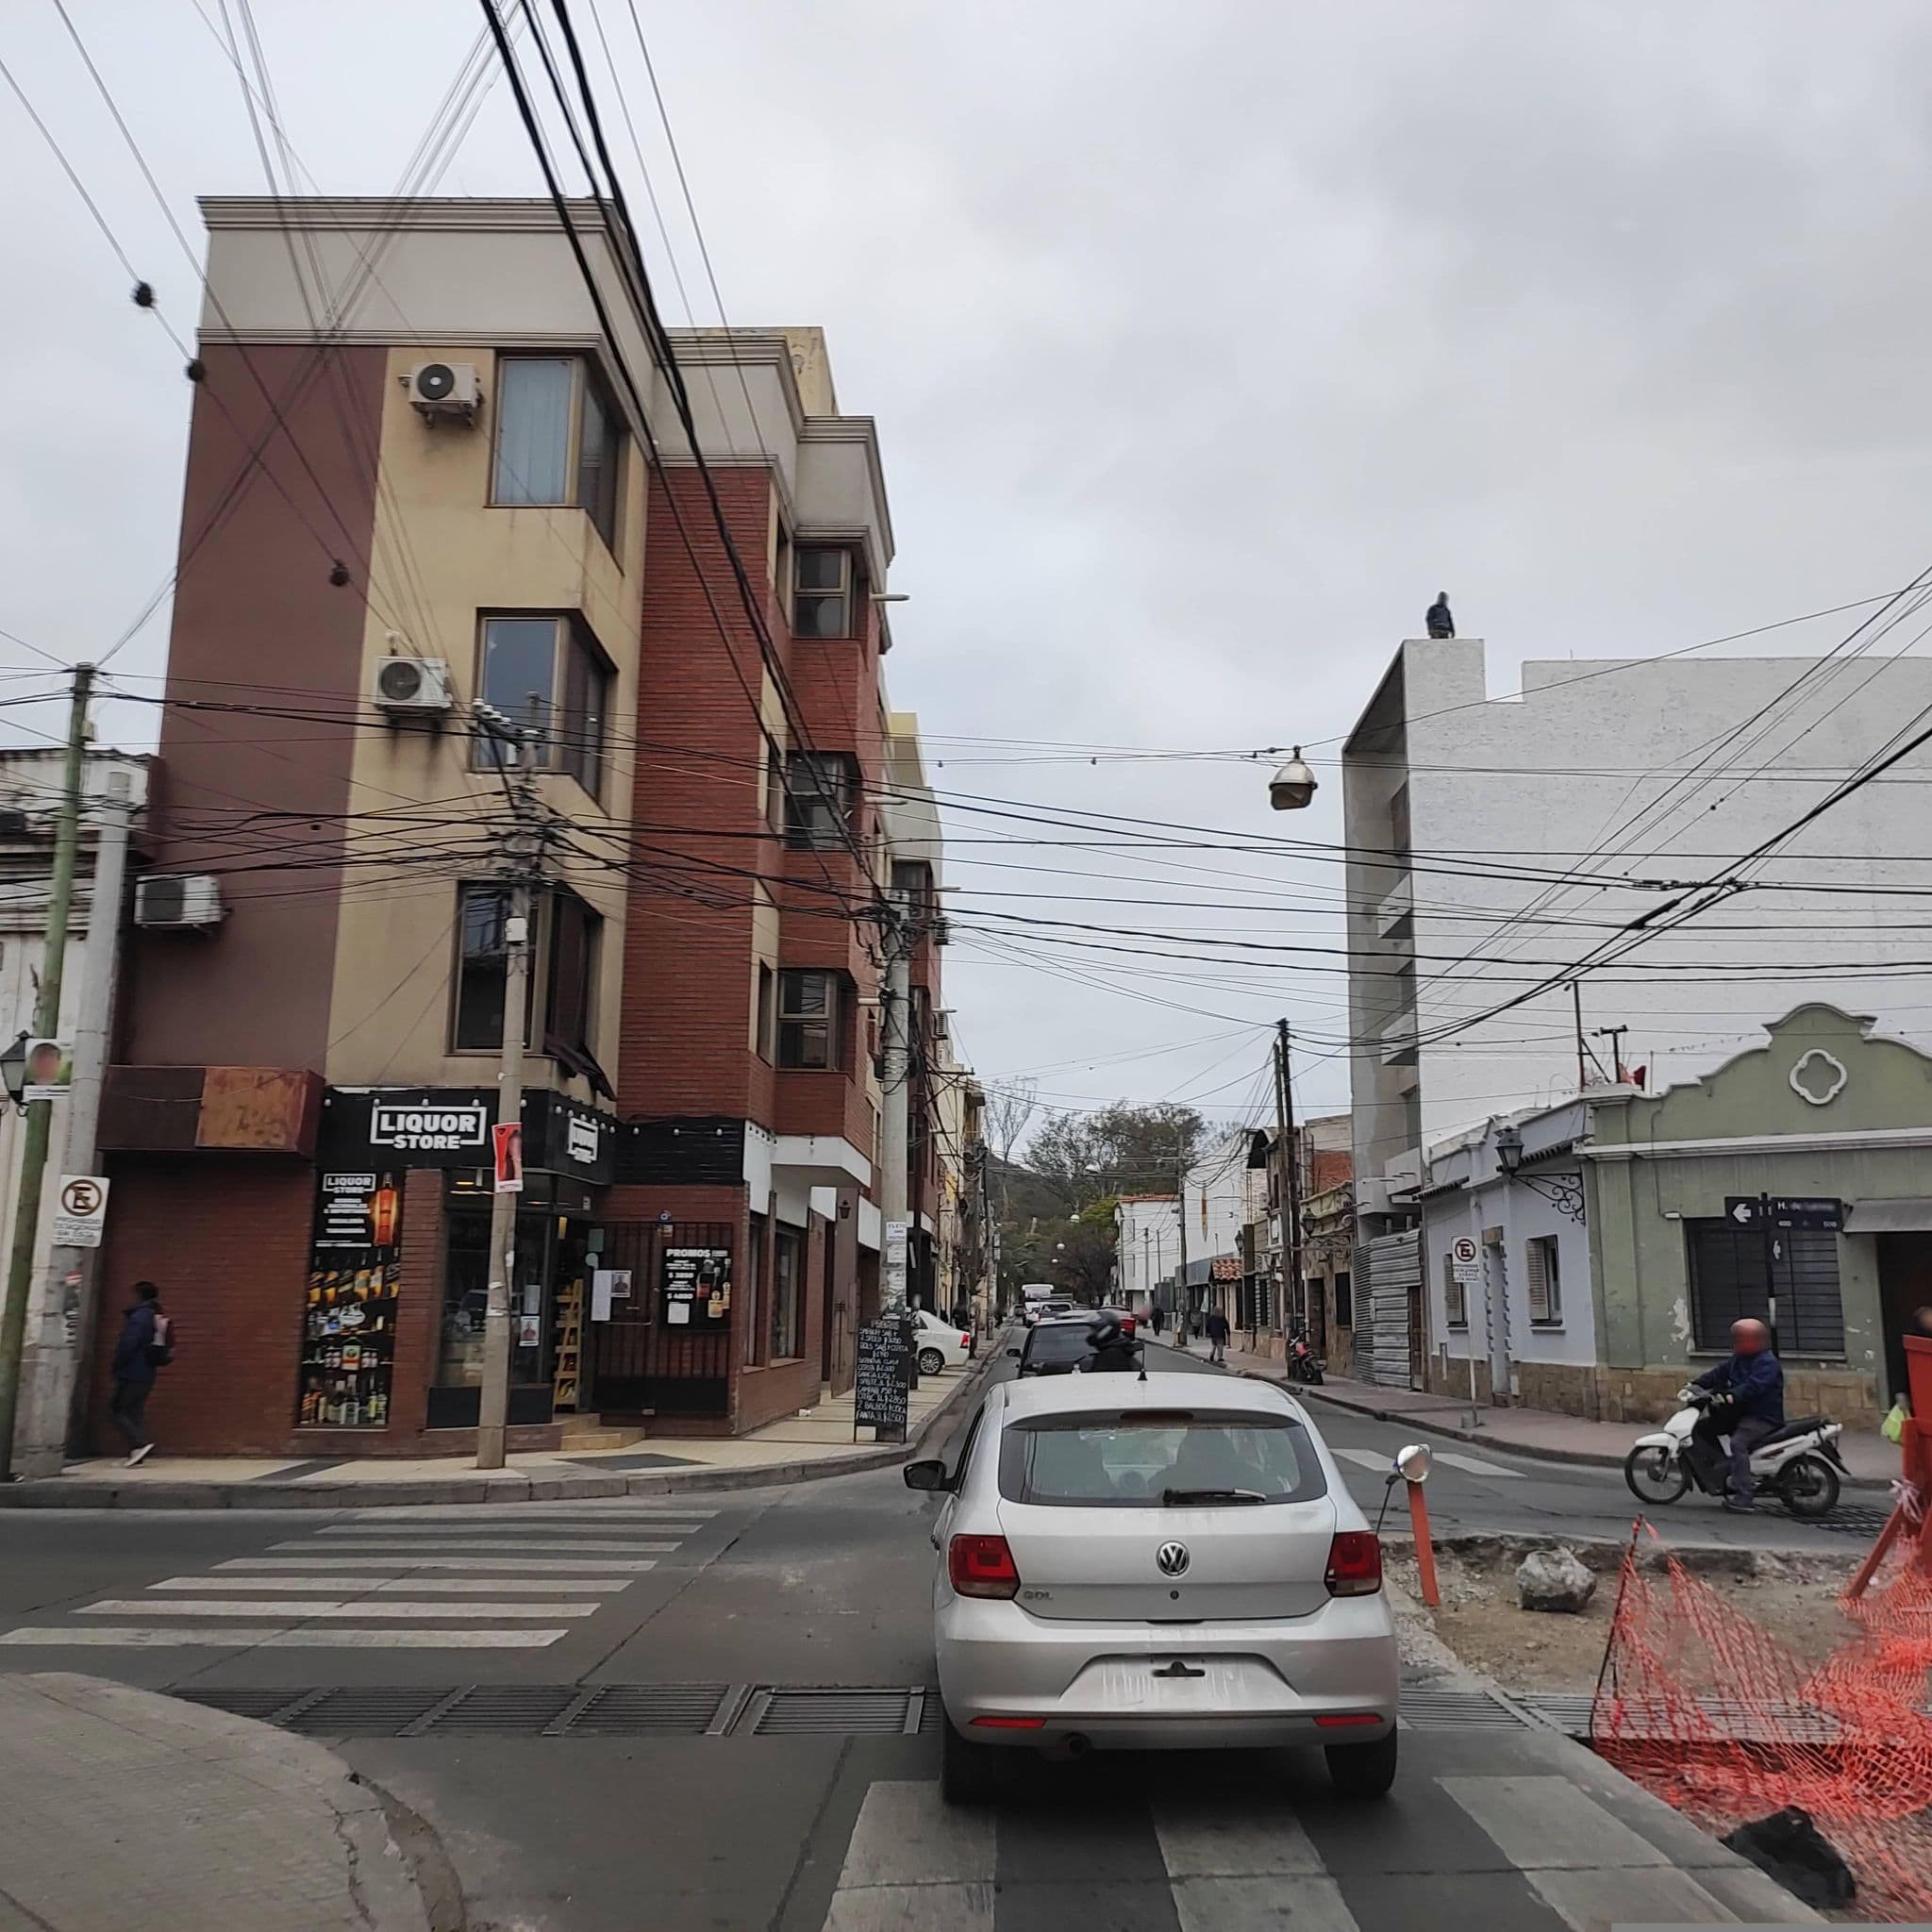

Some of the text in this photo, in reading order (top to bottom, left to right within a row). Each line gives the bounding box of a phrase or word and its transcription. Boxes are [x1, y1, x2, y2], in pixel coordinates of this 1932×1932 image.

[380, 1114, 476, 1132] LIQUOR
[393, 1134, 460, 1149] STORE
[327, 1177, 372, 1186] LIQUOR
[666, 1249, 710, 1257] PROMOS
[1024, 1591, 1054, 1600] GOL
